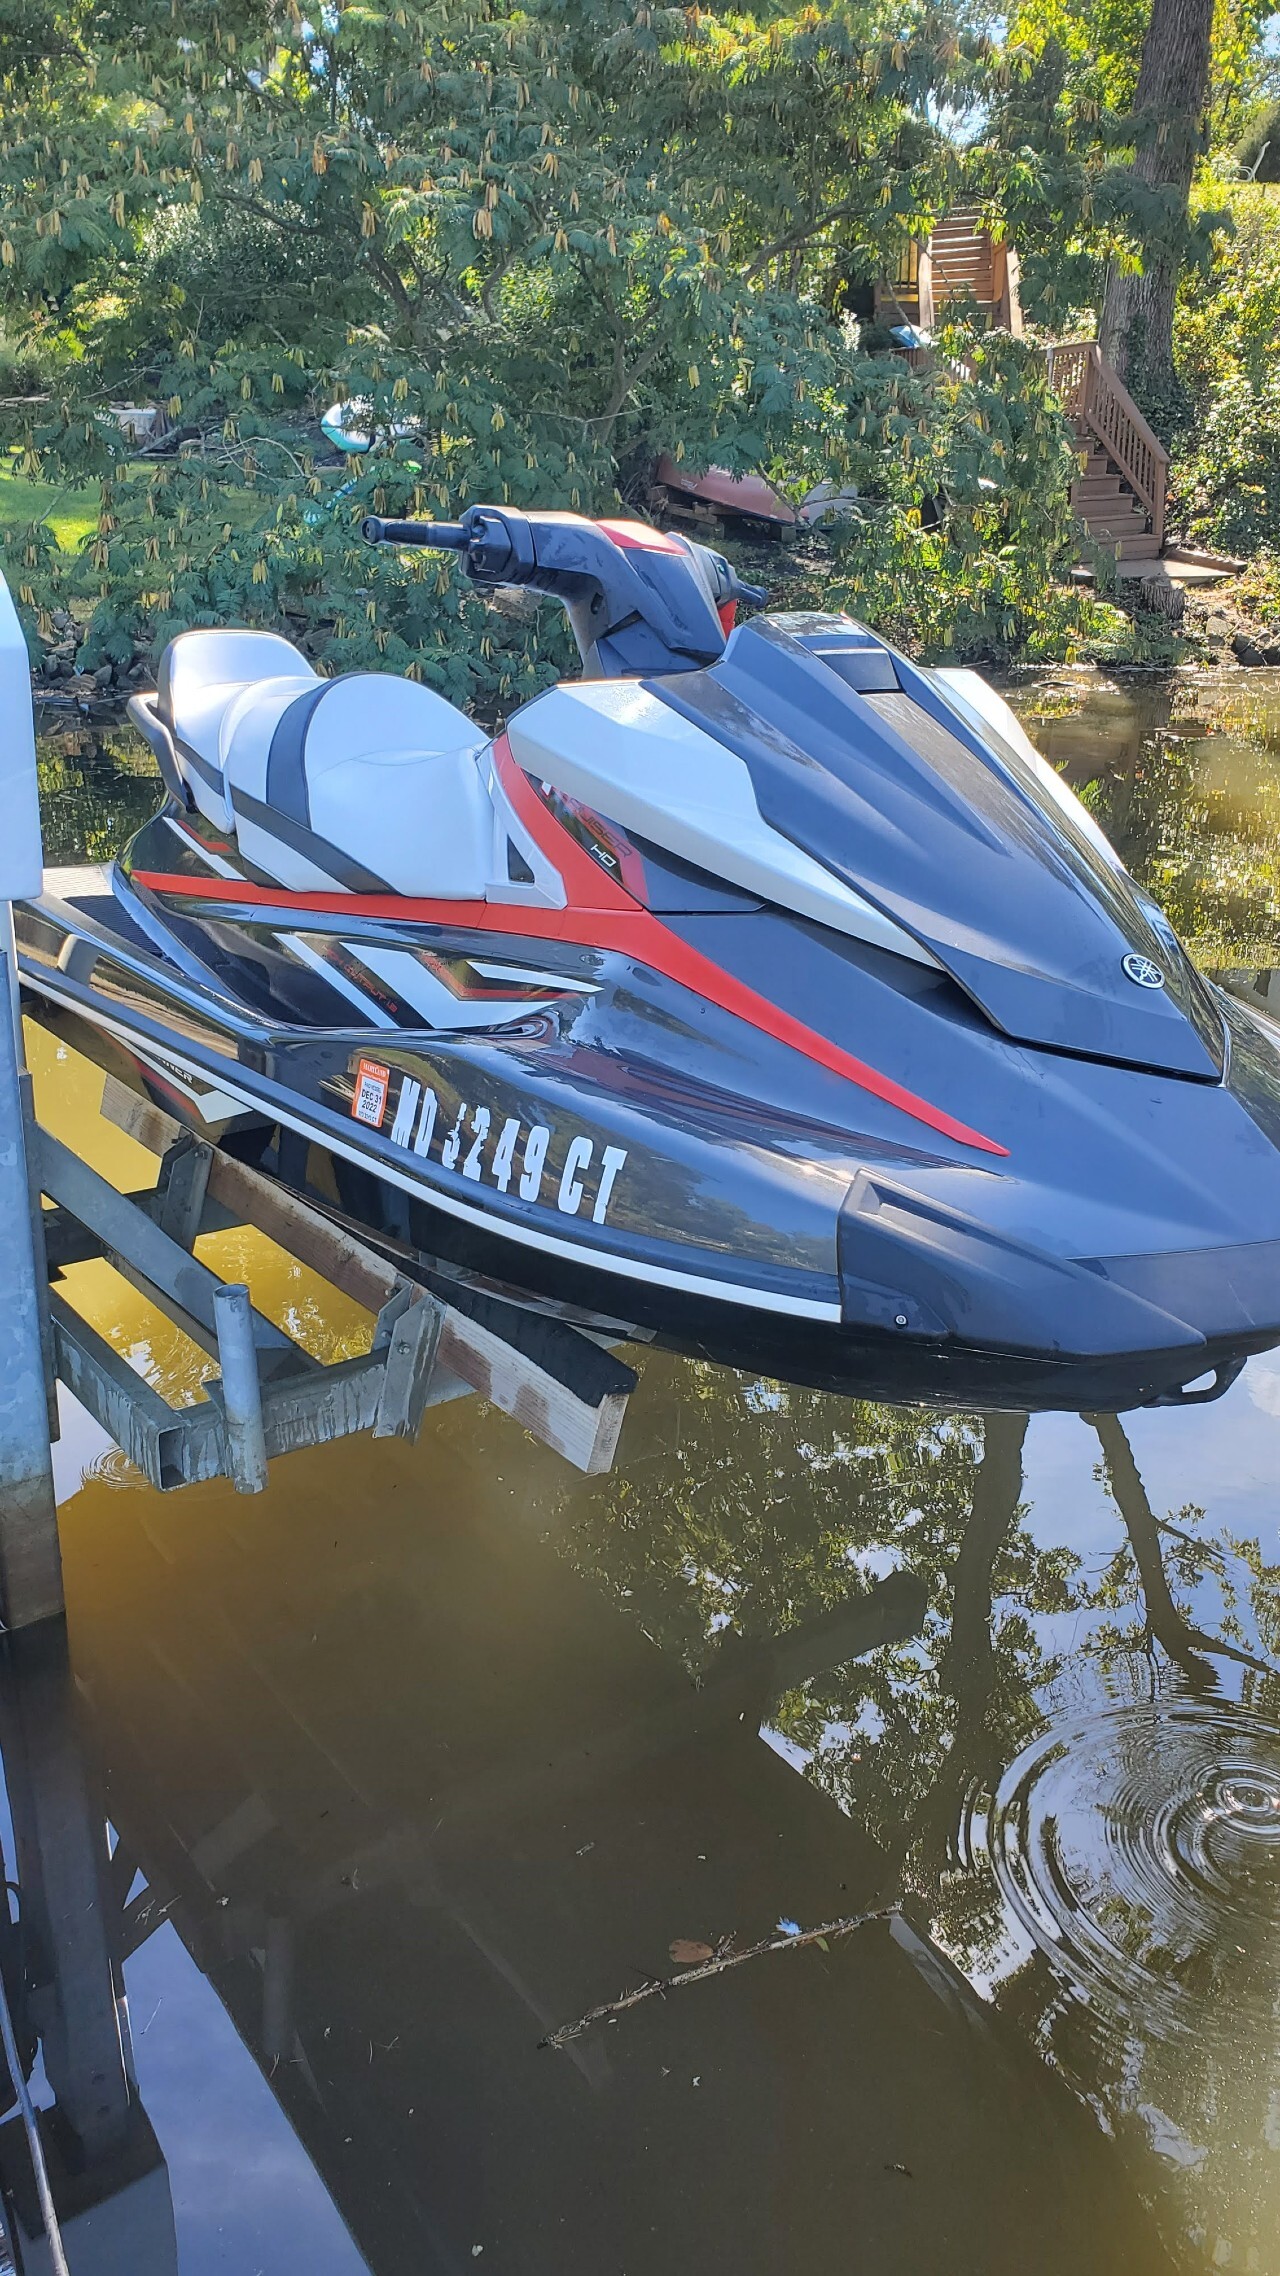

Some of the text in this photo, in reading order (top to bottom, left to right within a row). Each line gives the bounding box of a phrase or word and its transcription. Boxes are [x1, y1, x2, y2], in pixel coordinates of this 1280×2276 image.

[361, 1089, 382, 1104] DEC 31
[361, 1099, 378, 1113] 2022
[391, 1076, 438, 1158] MD
[558, 1135, 628, 1225] CT
